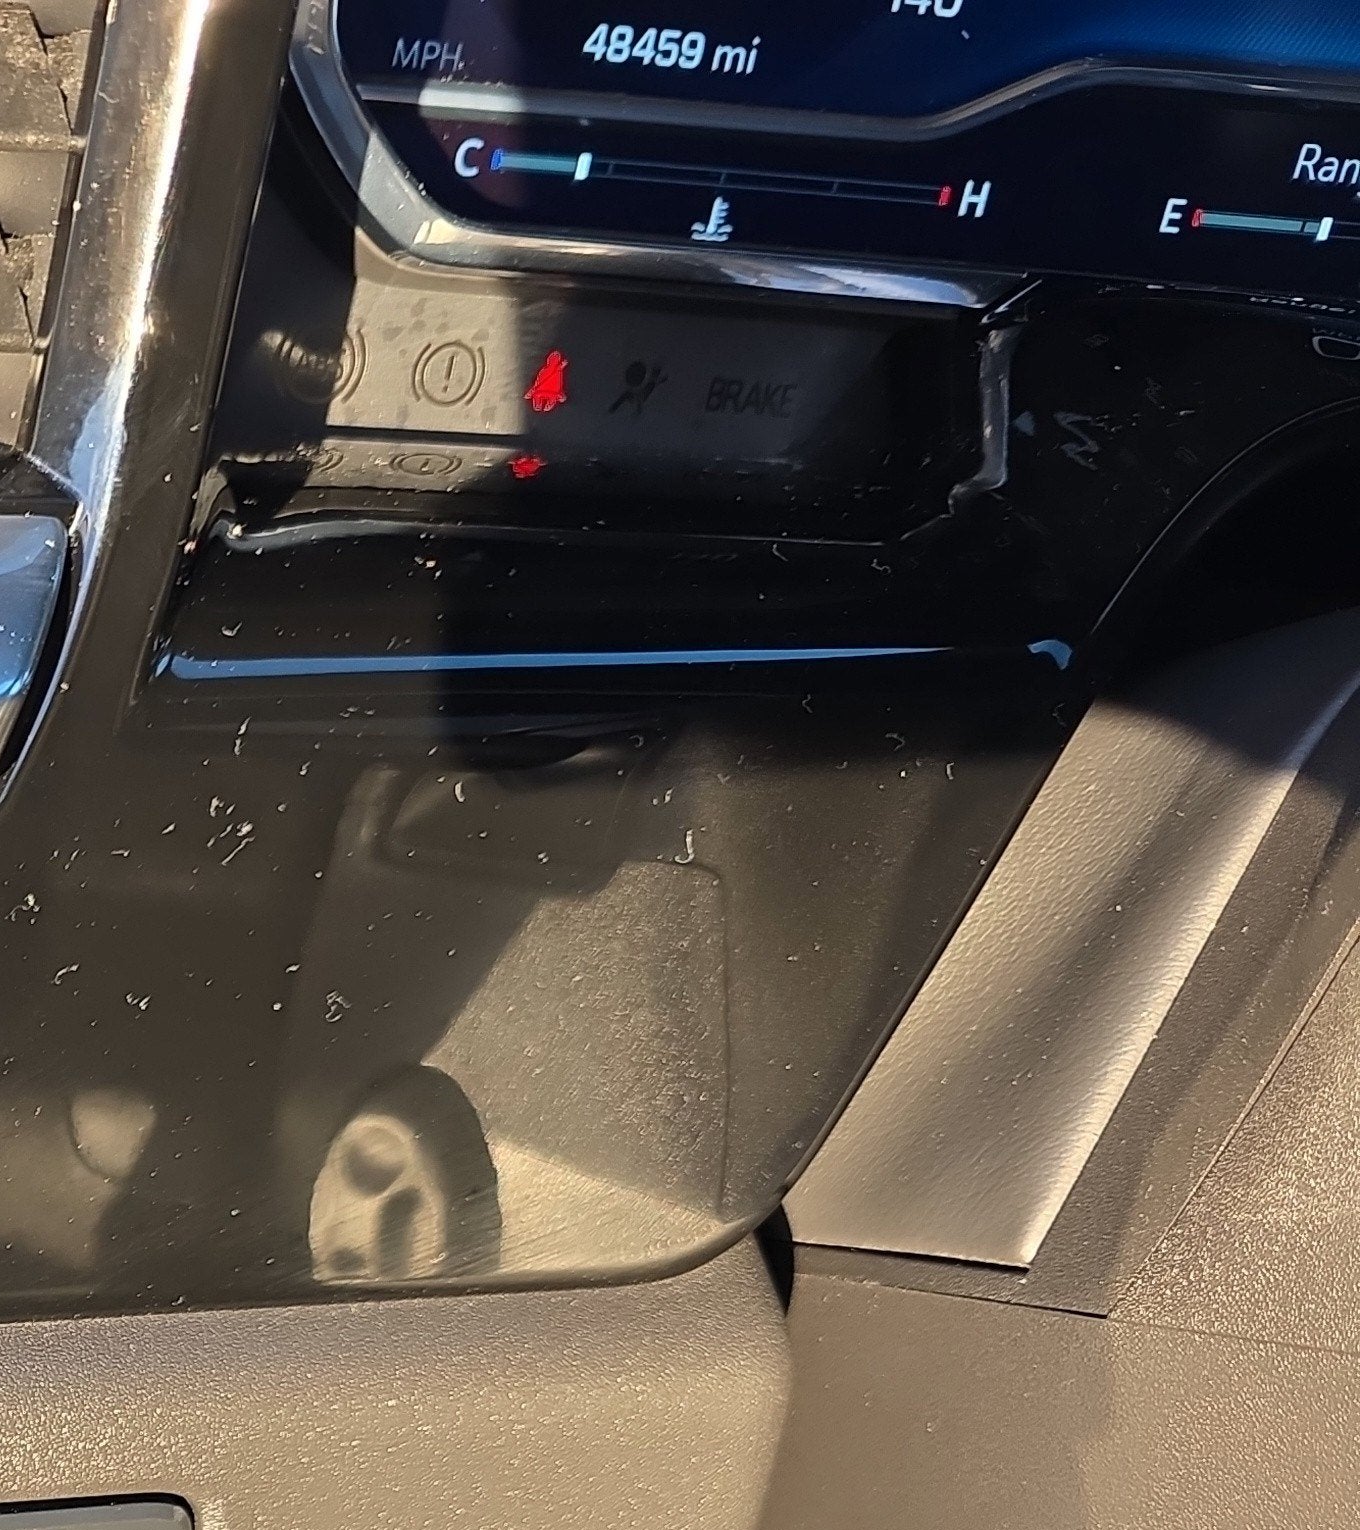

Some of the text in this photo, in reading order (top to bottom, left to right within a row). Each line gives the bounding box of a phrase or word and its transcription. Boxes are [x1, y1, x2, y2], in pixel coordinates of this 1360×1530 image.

[391, 37, 463, 72] MPH
[582, 22, 762, 75] 48459 mi
[453, 137, 486, 178] C
[1292, 143, 1360, 185] Ran
[957, 179, 992, 218] H
[1159, 198, 1188, 234] E
[705, 375, 797, 417] BRAKE
